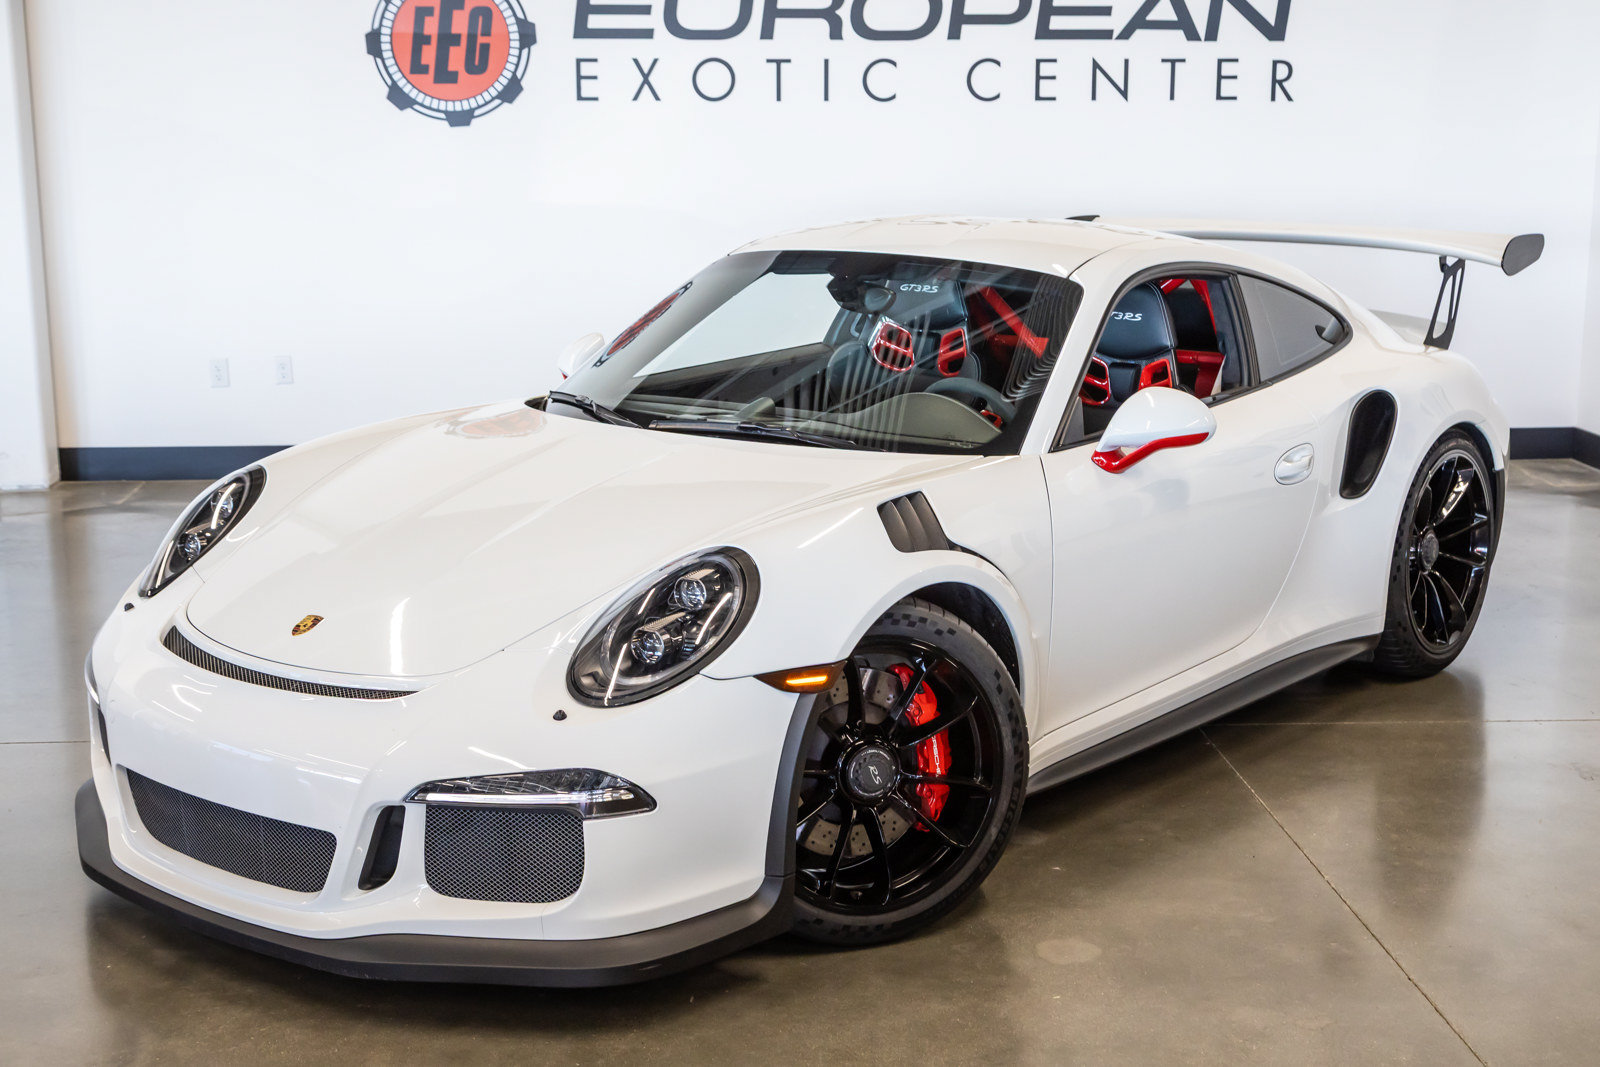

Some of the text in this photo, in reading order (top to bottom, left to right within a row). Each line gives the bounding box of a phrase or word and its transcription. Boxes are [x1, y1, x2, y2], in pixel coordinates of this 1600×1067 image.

[409, 0, 493, 84] EEC
[573, 0, 1291, 41] EUROPEAN
[576, 57, 1294, 102] EXOTIC CENTER
